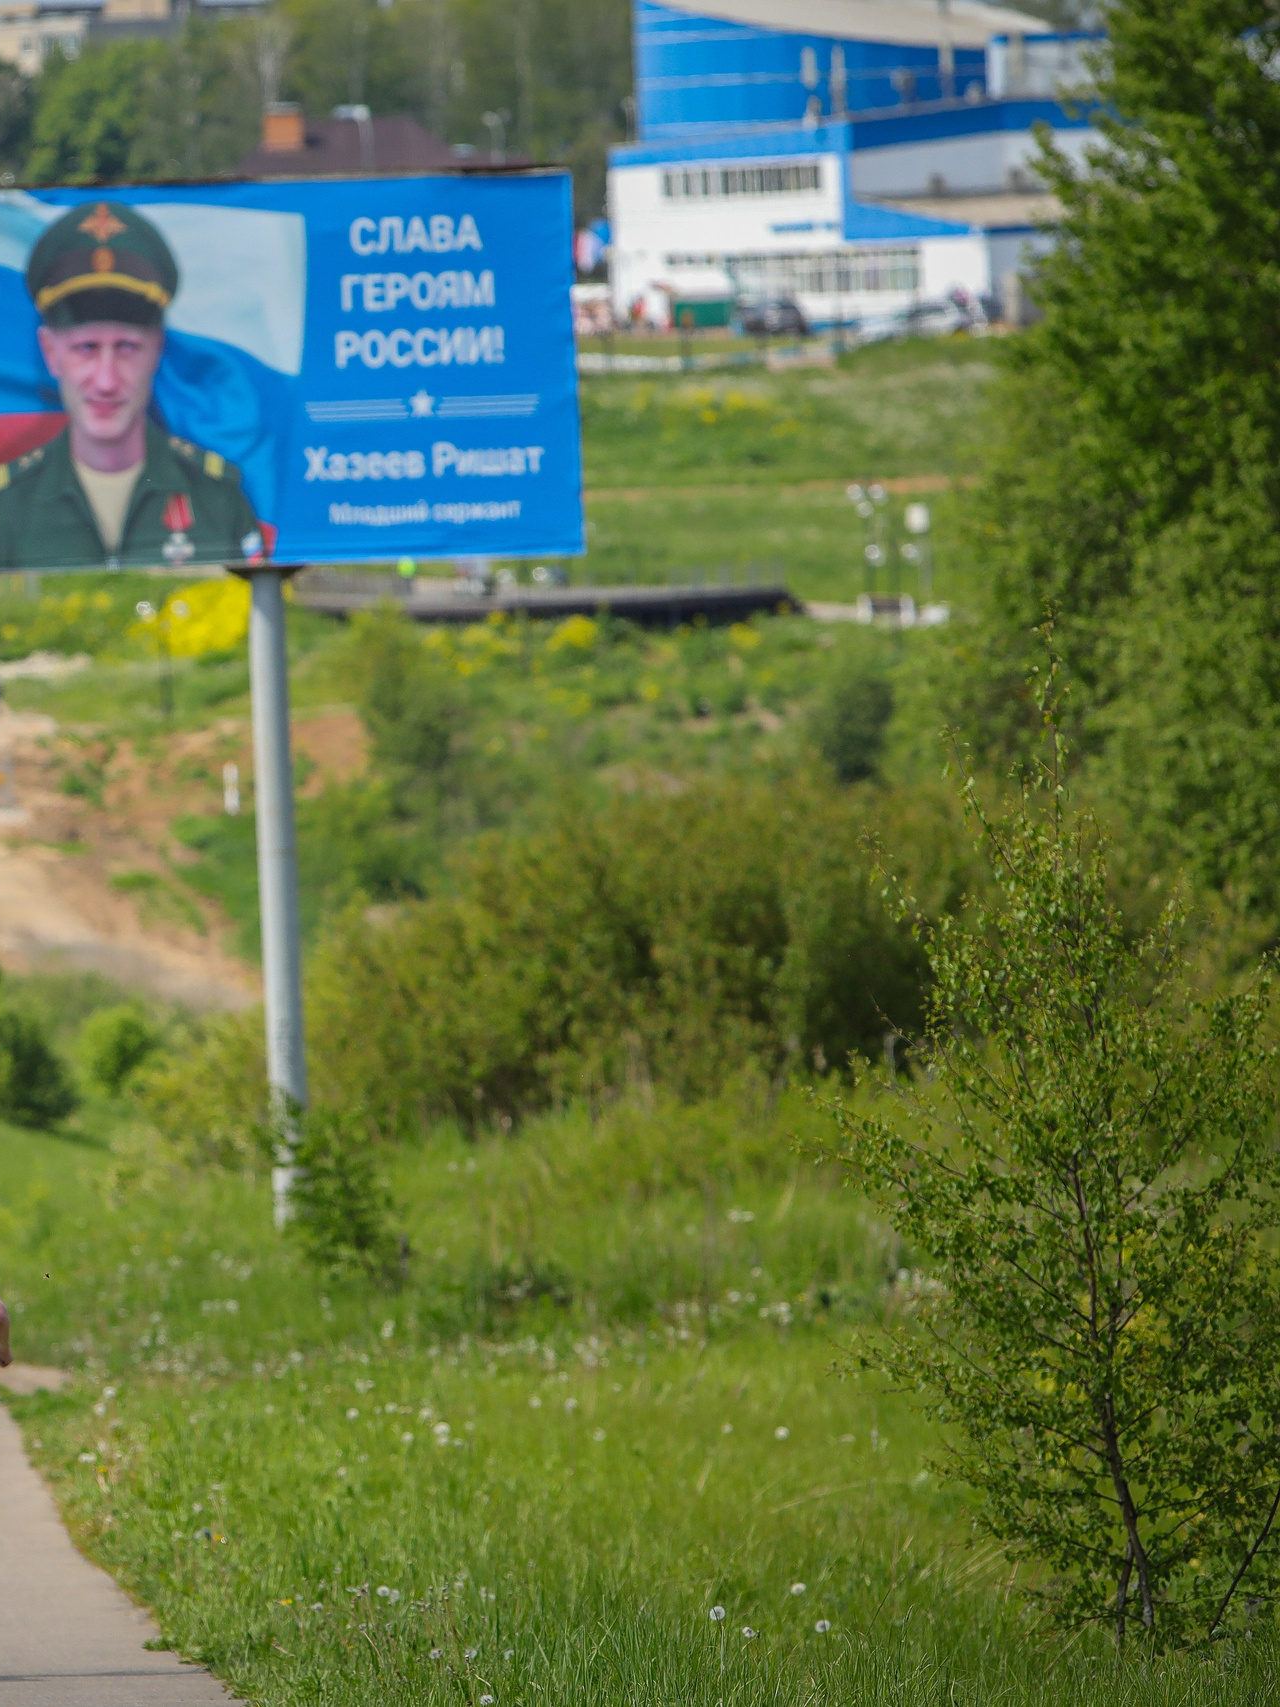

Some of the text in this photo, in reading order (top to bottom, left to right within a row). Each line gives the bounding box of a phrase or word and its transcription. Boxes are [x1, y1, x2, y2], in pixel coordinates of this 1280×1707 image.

[349, 213, 483, 256] СЛАВА
[340, 269, 495, 312] ГЕРОЯМ
[334, 325, 505, 369] РОССИИ!
[303, 440, 545, 482] Хазеев Ришат
